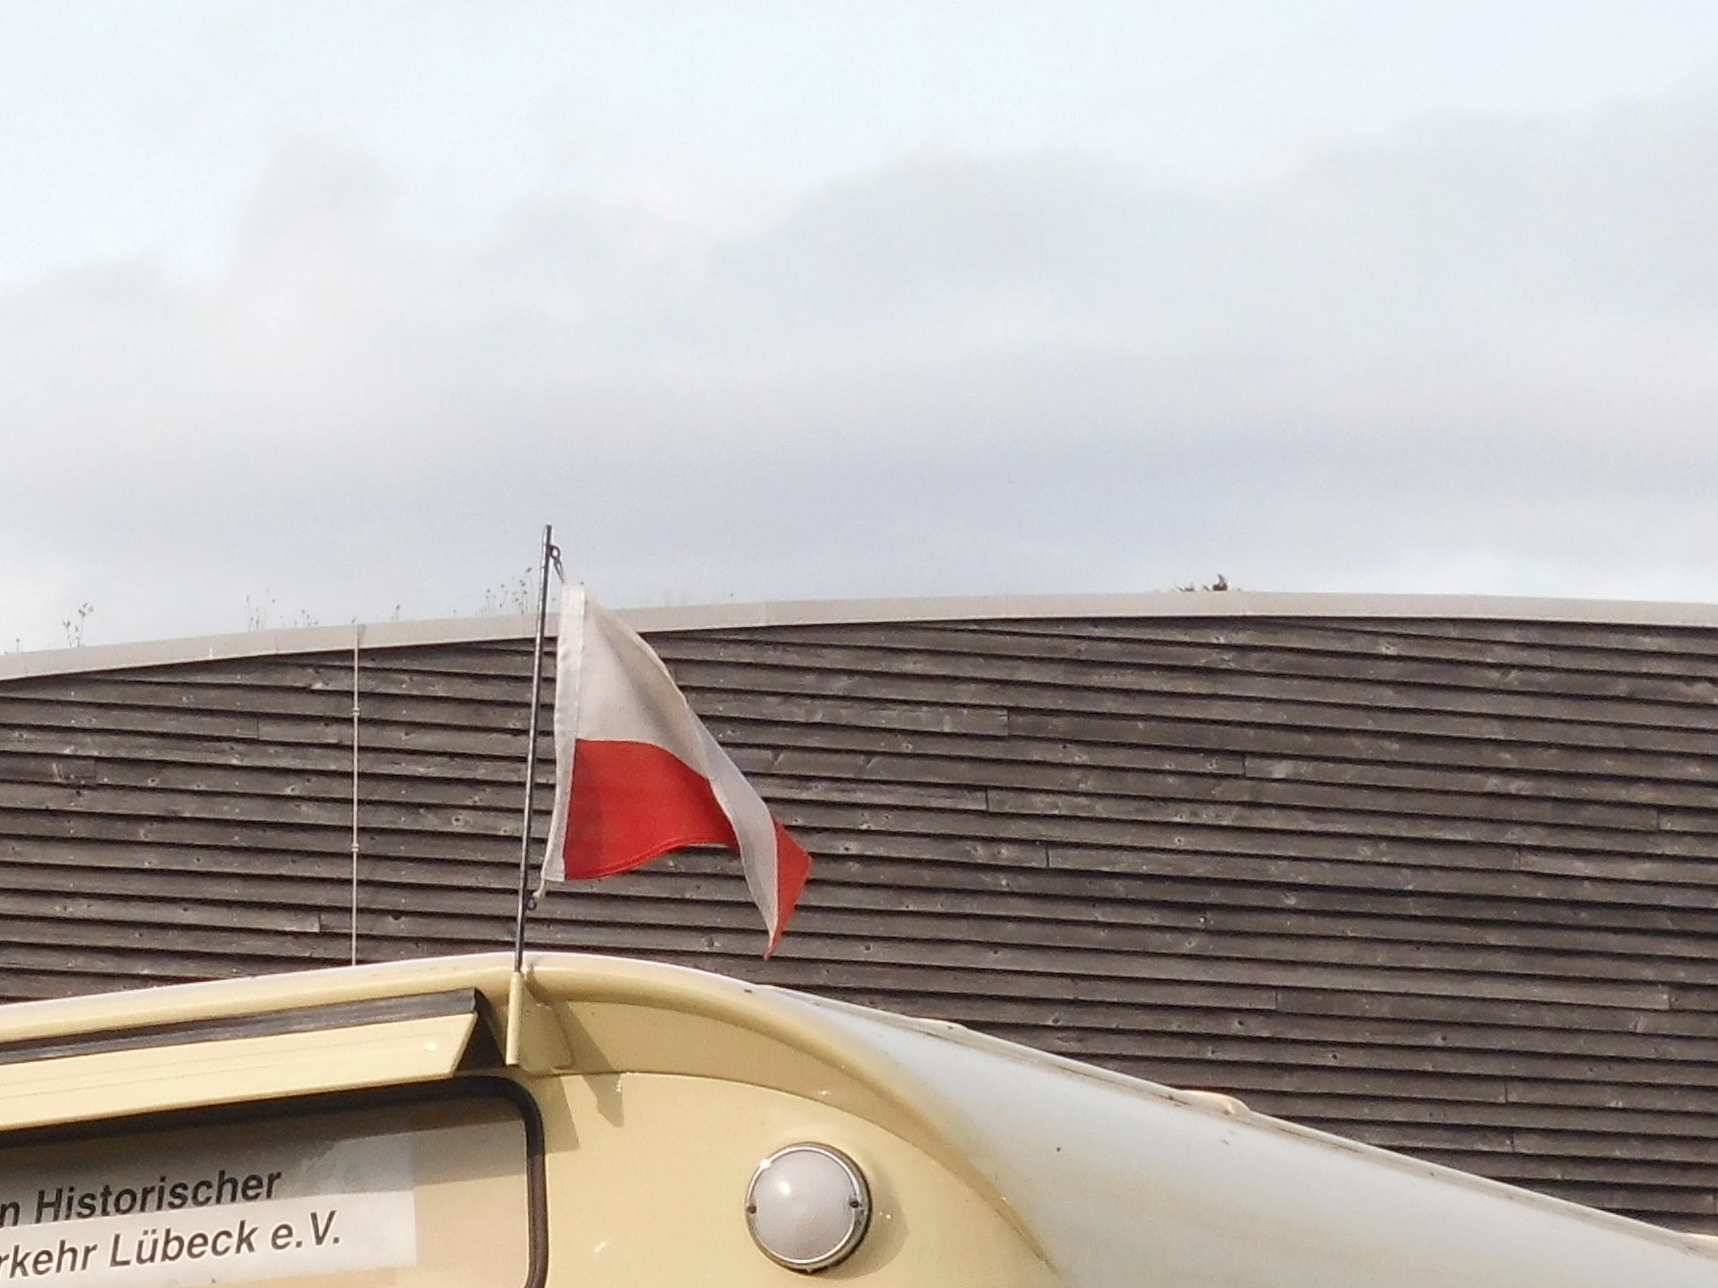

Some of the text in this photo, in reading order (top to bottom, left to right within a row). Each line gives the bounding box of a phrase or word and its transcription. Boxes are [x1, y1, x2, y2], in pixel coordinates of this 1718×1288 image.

[34, 1171, 282, 1224] Historischer
[110, 1219, 259, 1267] Lübeck
[271, 1210, 341, 1251] e.V.
